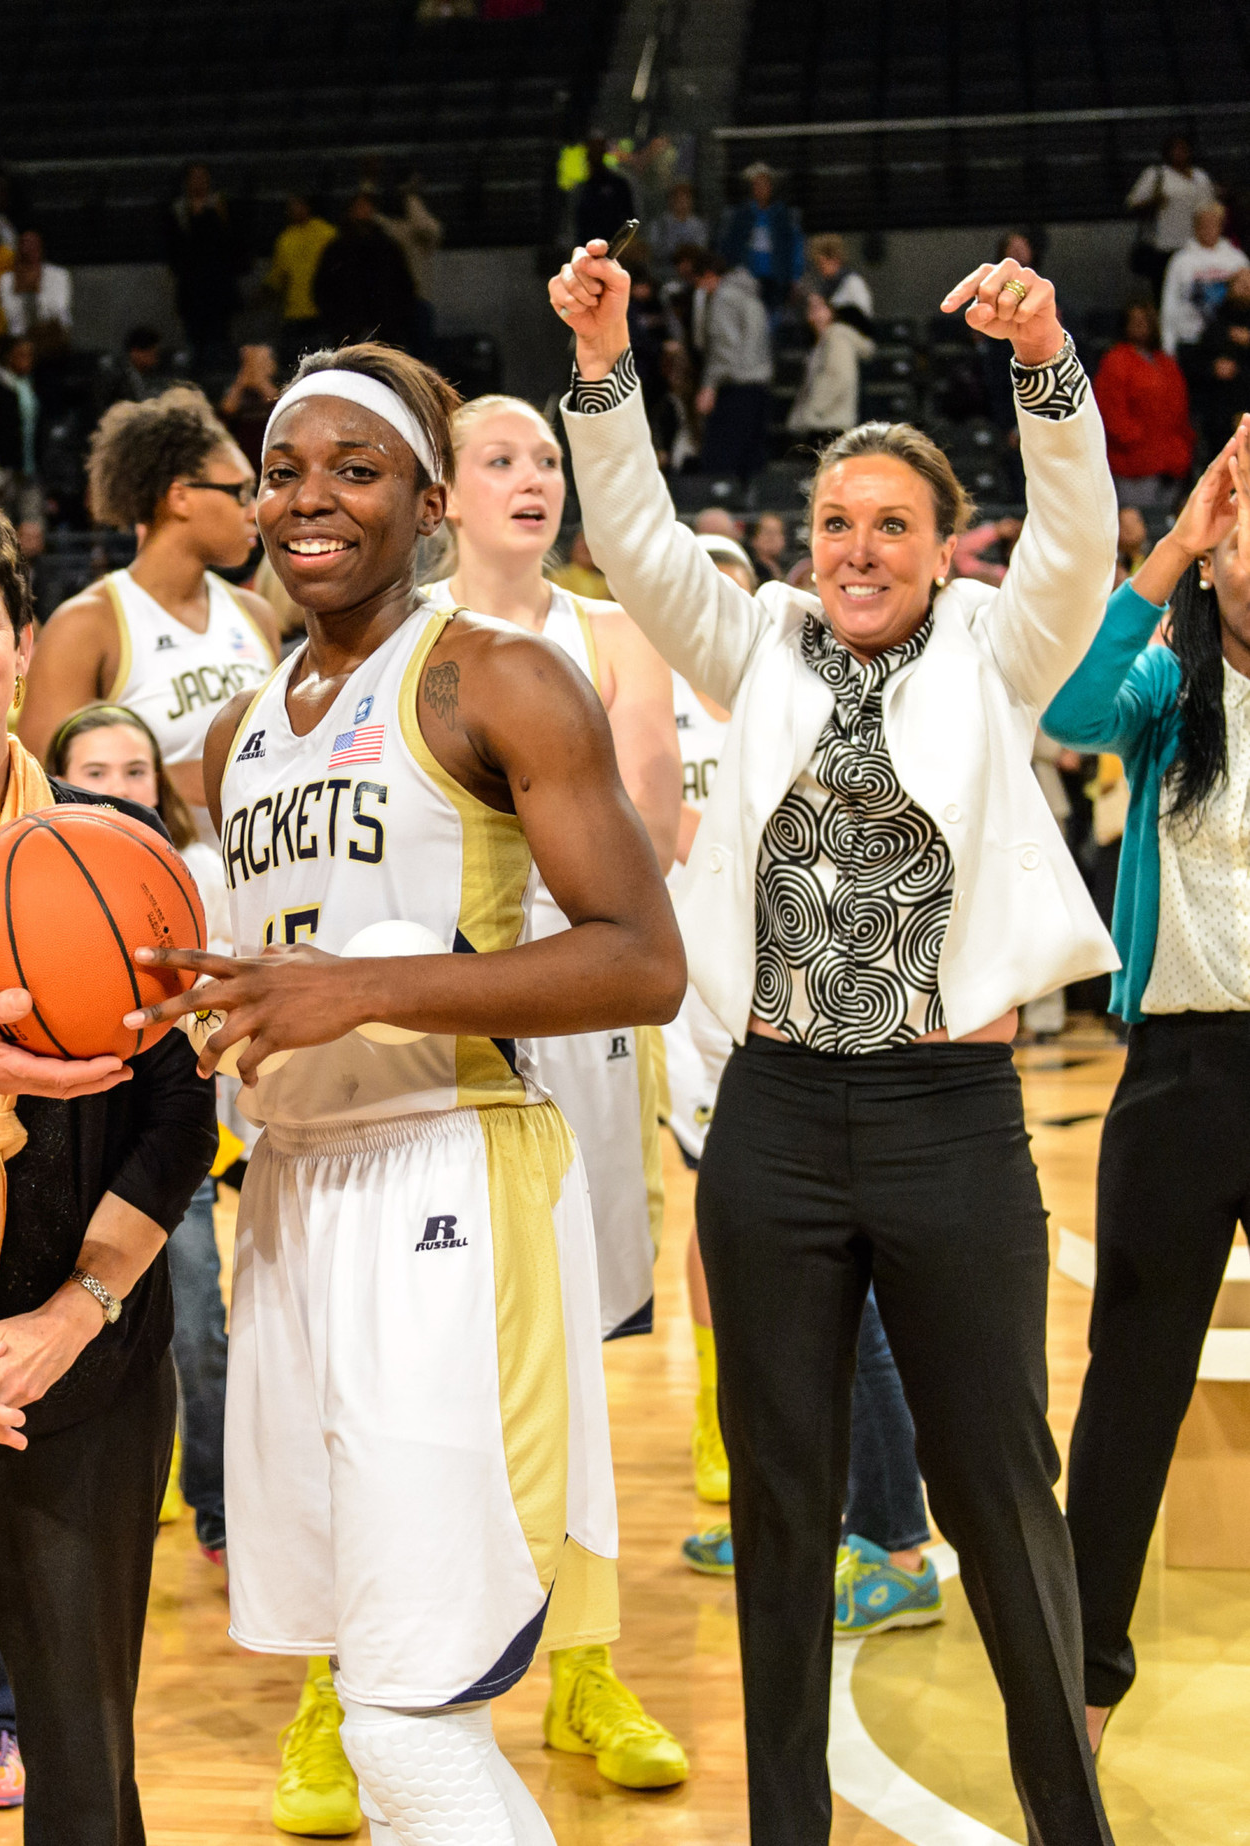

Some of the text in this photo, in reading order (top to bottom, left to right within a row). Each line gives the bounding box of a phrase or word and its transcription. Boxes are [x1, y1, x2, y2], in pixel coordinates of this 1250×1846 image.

[167, 663, 265, 719] JACKE
[423, 1214, 458, 1242] R
[415, 1237, 469, 1252] RUSSELL
